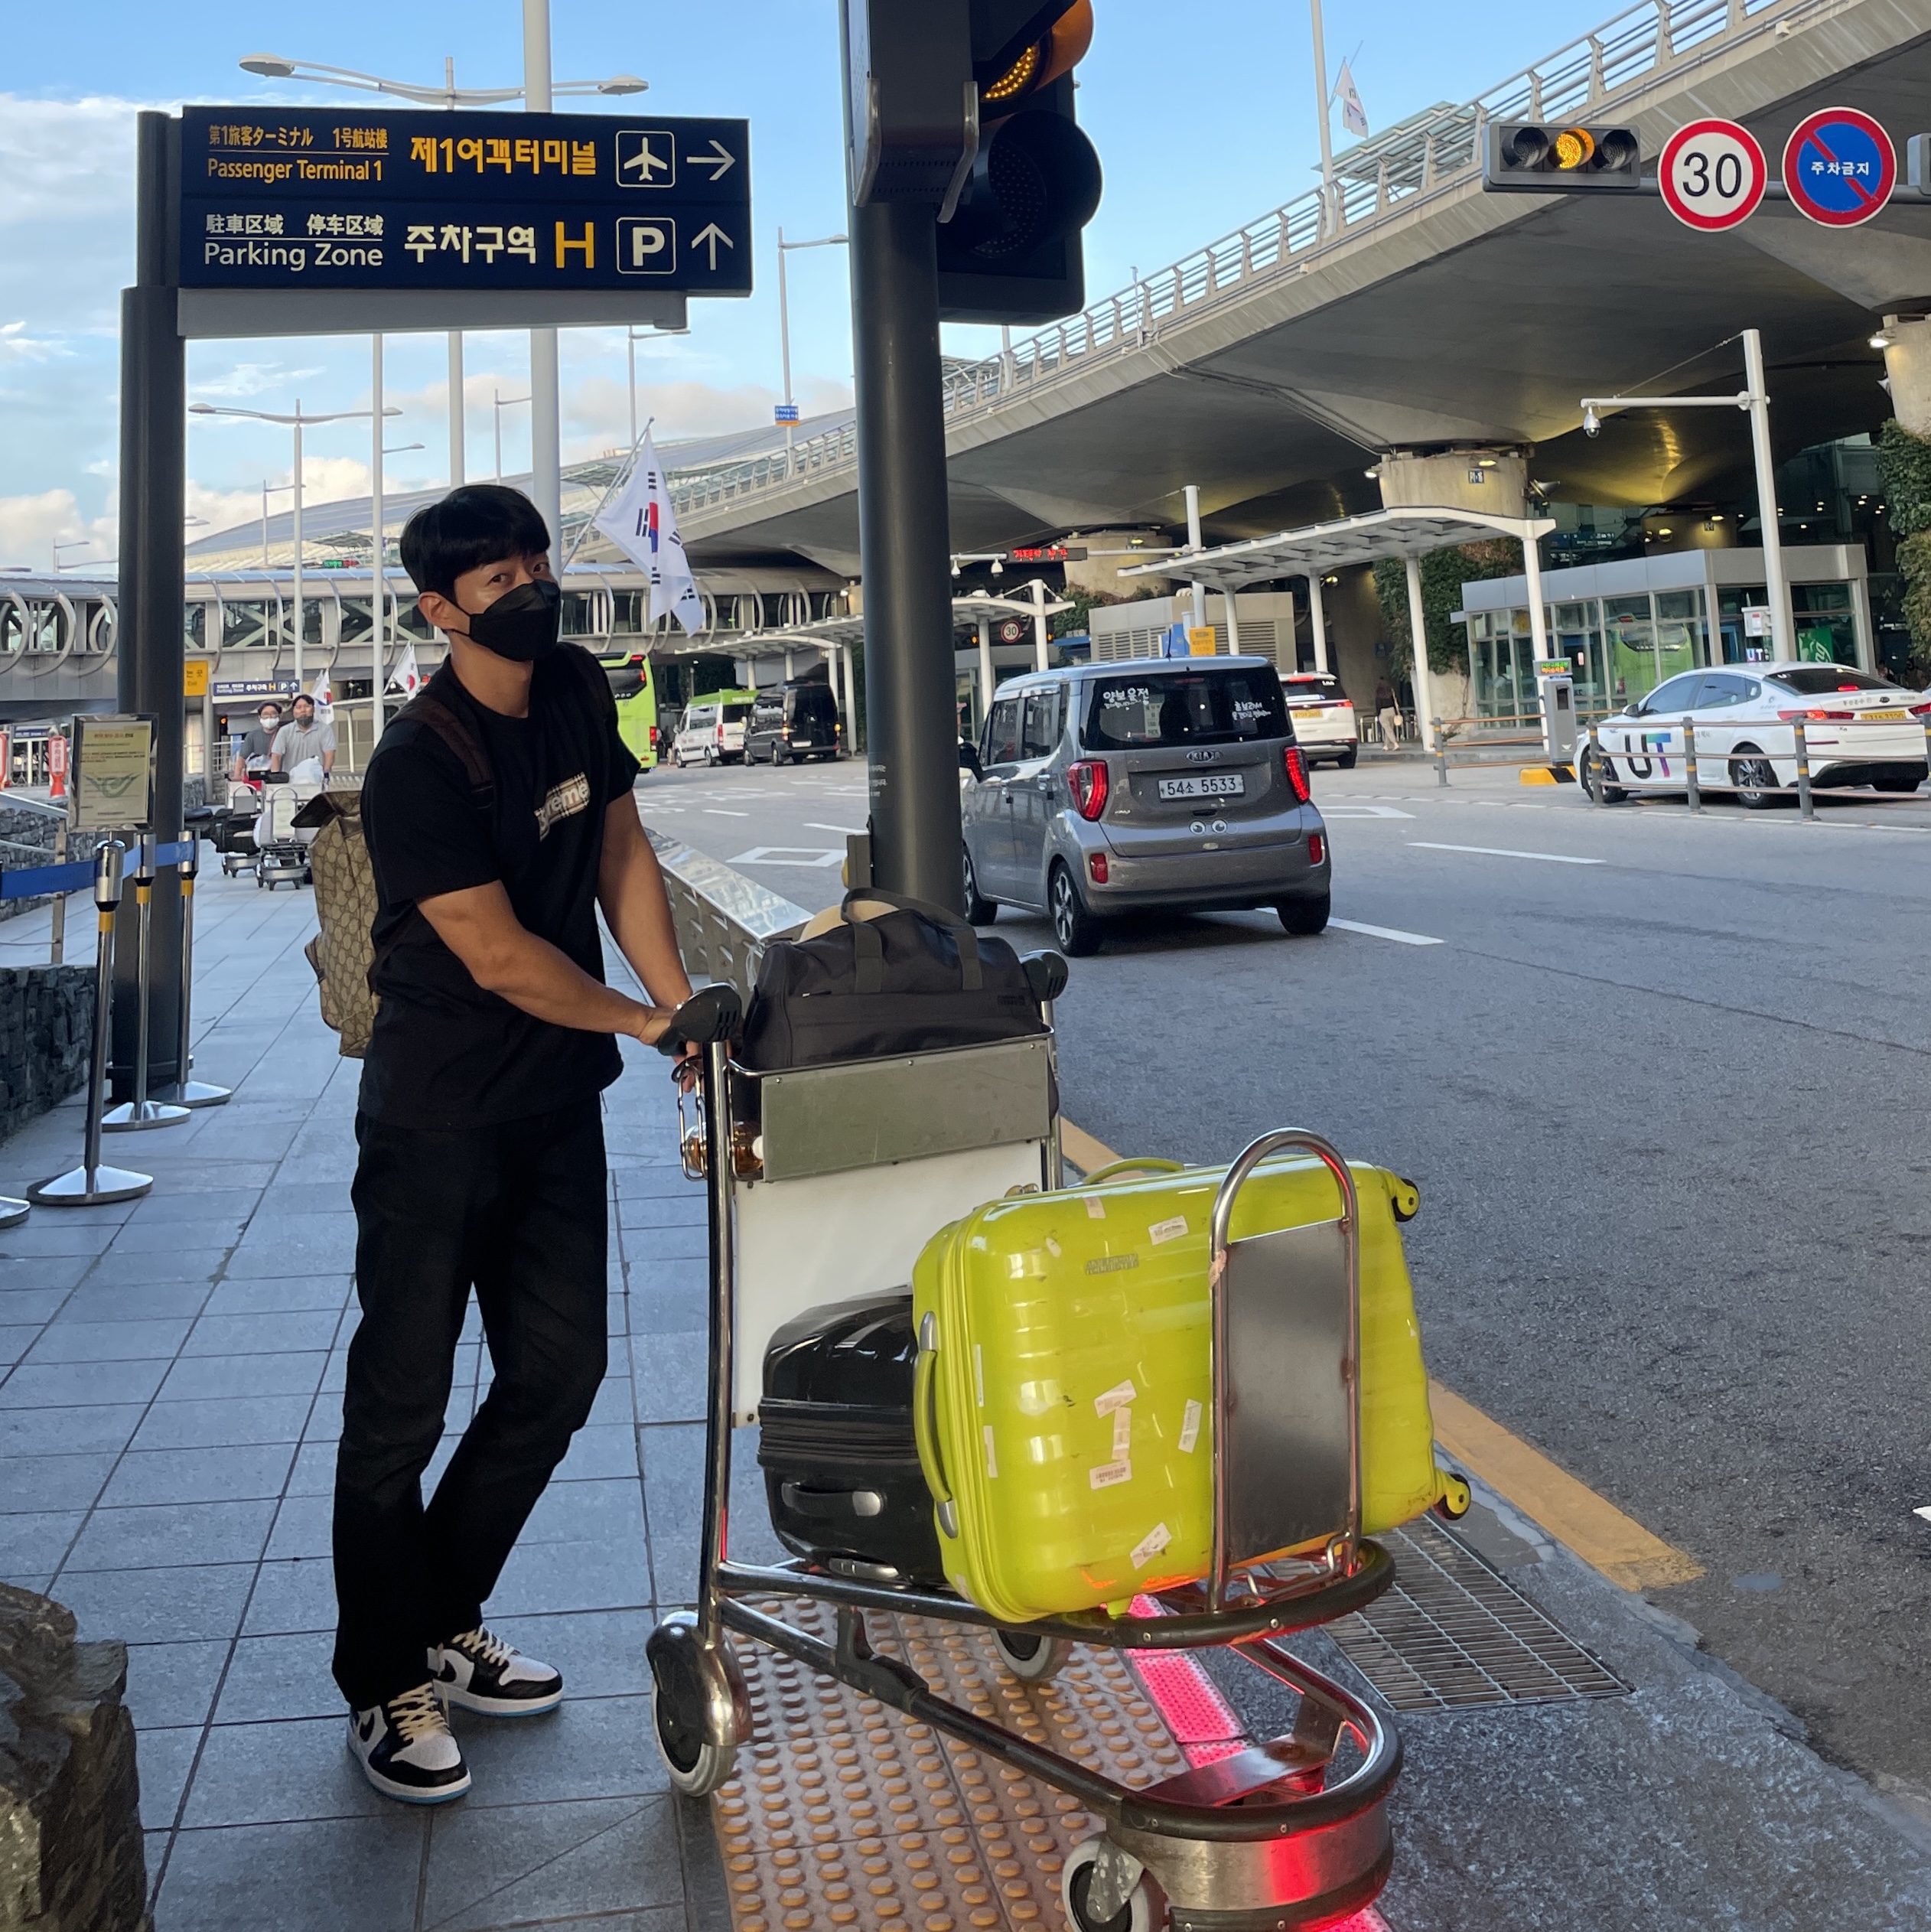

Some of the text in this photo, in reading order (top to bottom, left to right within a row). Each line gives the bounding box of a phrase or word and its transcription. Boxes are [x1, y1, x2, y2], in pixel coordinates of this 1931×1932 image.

[208, 124, 314, 148] 第1旅客ターミナル
[409, 137, 596, 176] 제1여객터미널
[1810, 161, 1870, 175] 주차금지
[207, 158, 383, 184] Passenger Terminal 1
[1682, 151, 1742, 198] 30
[206, 213, 285, 235] 駐車区域
[306, 213, 385, 236] 停车区域
[204, 240, 384, 272] Parking Zone
[403, 221, 666, 269] 주차구역 H P
[1005, 626, 1018, 636] 30
[269, 683, 276, 691] H
[1624, 732, 1672, 780] UT
[1167, 777, 1236, 796] 54소 5533
